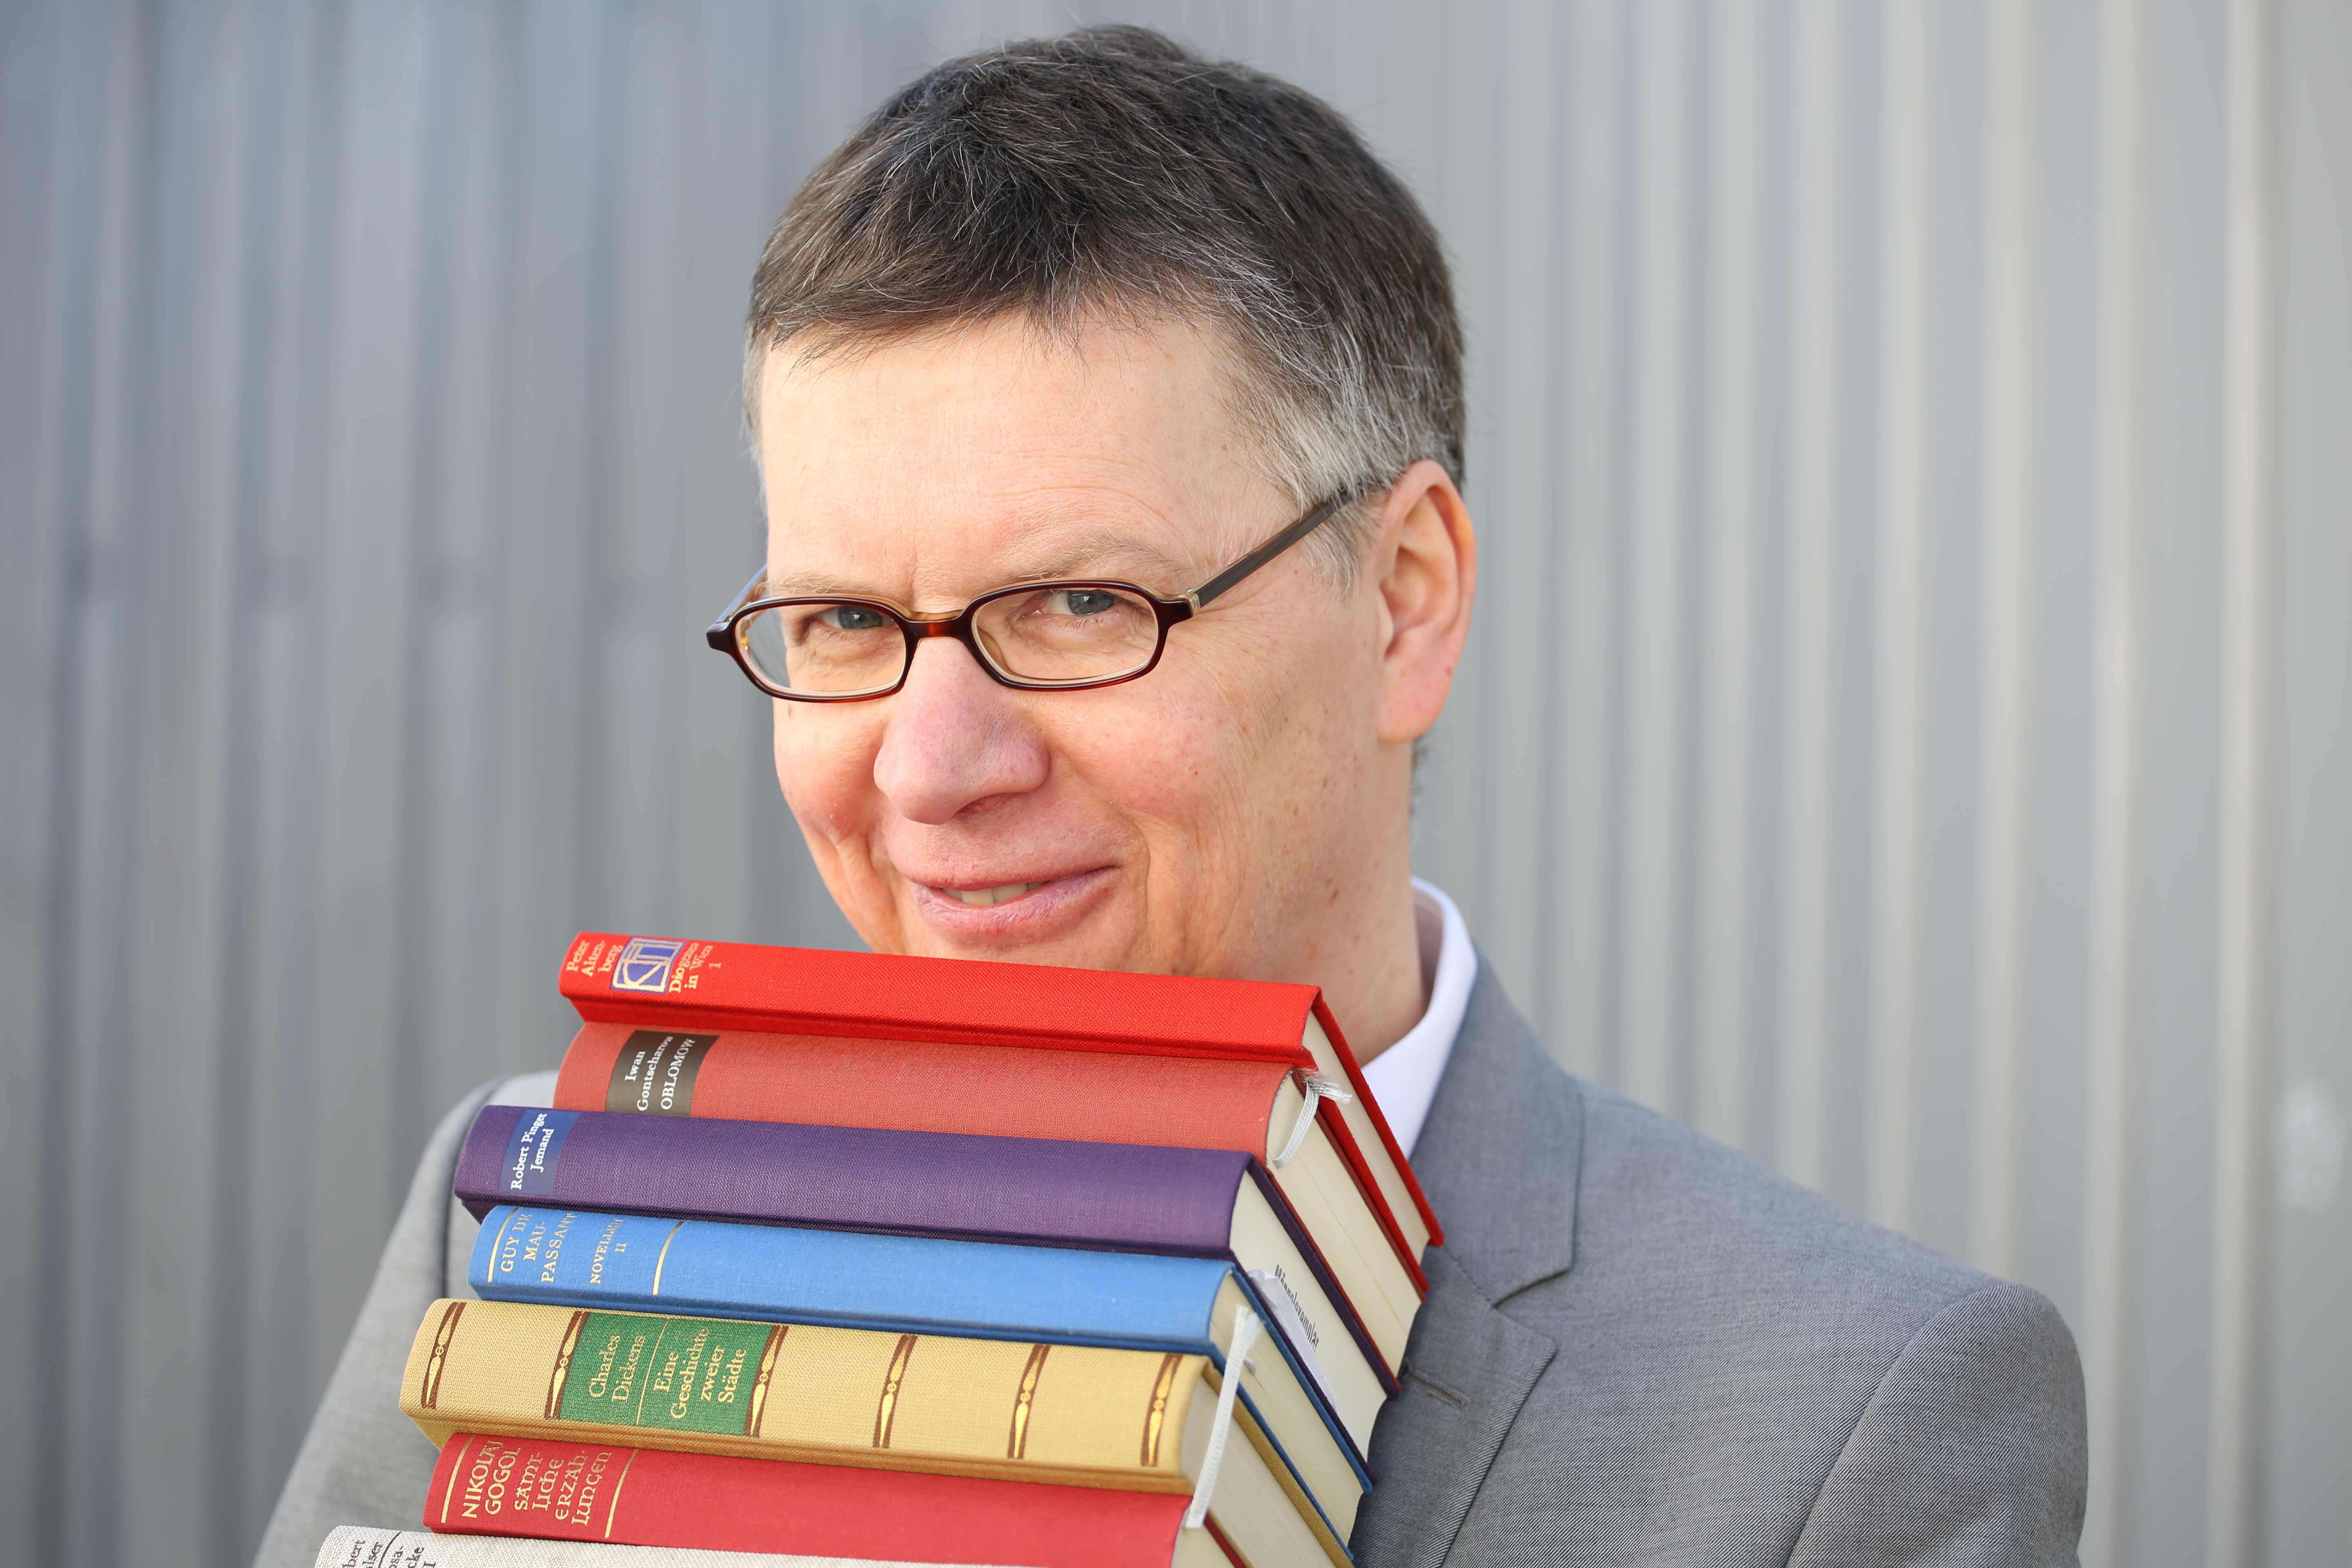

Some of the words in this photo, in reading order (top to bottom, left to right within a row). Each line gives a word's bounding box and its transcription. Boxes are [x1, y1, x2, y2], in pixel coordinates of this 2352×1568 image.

[566, 940, 589, 972] Peter
[598, 944, 624, 972] berg
[684, 975, 698, 989] in
[690, 945, 713, 970] Wien
[624, 1050, 646, 1082] Iwan
[637, 1036, 673, 1111] Gontscharow
[660, 1038, 695, 1110] OBLOMOW
[511, 1146, 529, 1190] Robert
[521, 1113, 547, 1143] Pinget
[530, 1128, 555, 1173] Jemand
[501, 1236, 519, 1272] GUY
[512, 1214, 532, 1232] DE
[523, 1222, 547, 1261] MAU-
[541, 1212, 577, 1283] PASSANT
[590, 1218, 624, 1284] NOVELLEN
[615, 1242, 628, 1253] II
[588, 1335, 621, 1398] Charles
[612, 1335, 646, 1402] Dickens
[654, 1350, 680, 1392] Eine
[670, 1326, 710, 1419] Geschichte
[701, 1345, 726, 1402] zweier
[717, 1349, 747, 1403] Städte
[485, 1448, 521, 1515] GOGOL
